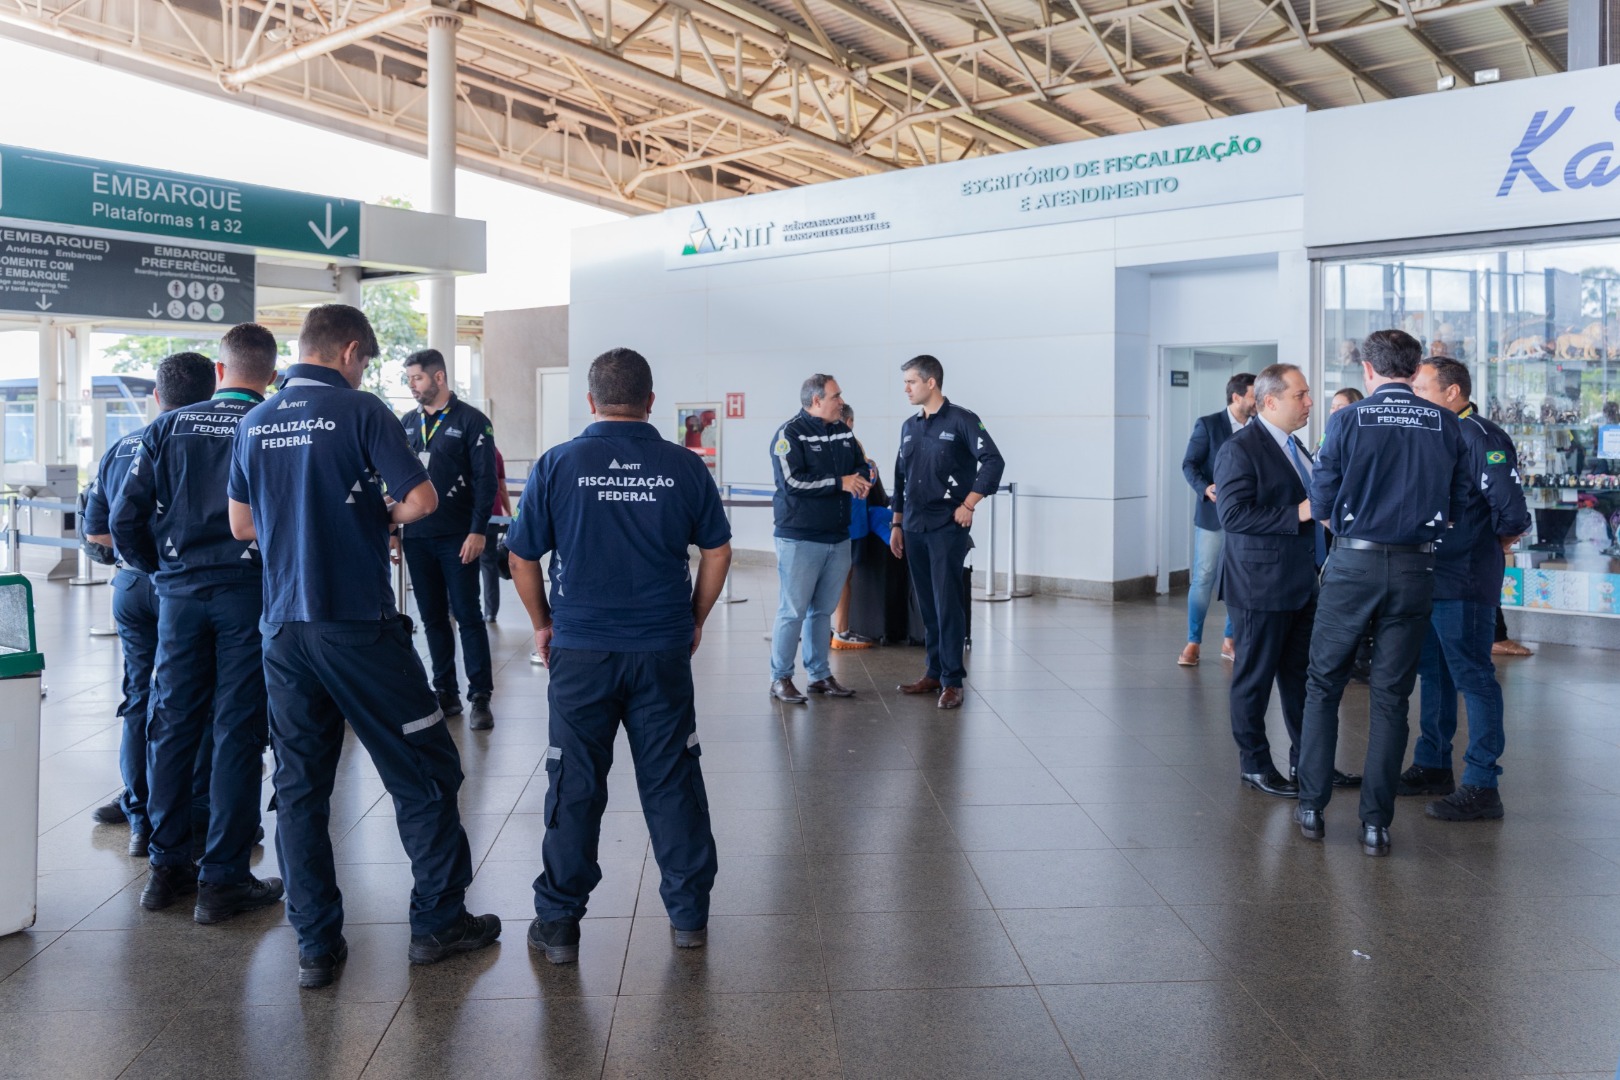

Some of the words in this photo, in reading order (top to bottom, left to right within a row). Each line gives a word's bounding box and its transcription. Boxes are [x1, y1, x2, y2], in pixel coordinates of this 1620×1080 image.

[1496, 100, 1620, 197] Ka
[961, 166, 1069, 196] ESCRITÓRIO
[1073, 160, 1100, 179] DE
[1103, 136, 1262, 174] FISCALIZAÇÃO
[92, 172, 242, 213] EMBARQUE
[1019, 196, 1031, 212] E
[1037, 176, 1179, 210] ATENDIMENTO
[92, 202, 194, 228] Plataformas
[198, 216, 205, 229] 1
[210, 219, 220, 231] a
[223, 219, 242, 234] 32
[782, 221, 819, 232] AGÊNCIA
[819, 213, 863, 227] NACIONAL
[863, 212, 876, 221] DE
[784, 228, 839, 242] TRANSPORTES
[840, 221, 890, 235] TERRESTRES
[6, 244, 49, 256] Andenes
[56, 249, 103, 261] Embarque
[154, 246, 226, 262] EMBARQUE
[0, 255, 47, 269] OMENTE
[49, 260, 74, 271] COM
[141, 256, 237, 275] PREFERÊNCIAL
[5, 267, 70, 282] EMBARQUE.
[289, 400, 308, 409] ANTT
[728, 395, 743, 417] H
[1360, 406, 1438, 418] FISCALIZAÇÃO
[193, 423, 235, 435] FEDERA
[247, 417, 336, 438] FISCALIZAÇÃO
[1377, 415, 1423, 426] FEDERAL
[261, 434, 313, 450] FEDERAL
[578, 475, 675, 489] FISCALIZAÇÃO
[597, 490, 656, 501] FEDERAL
